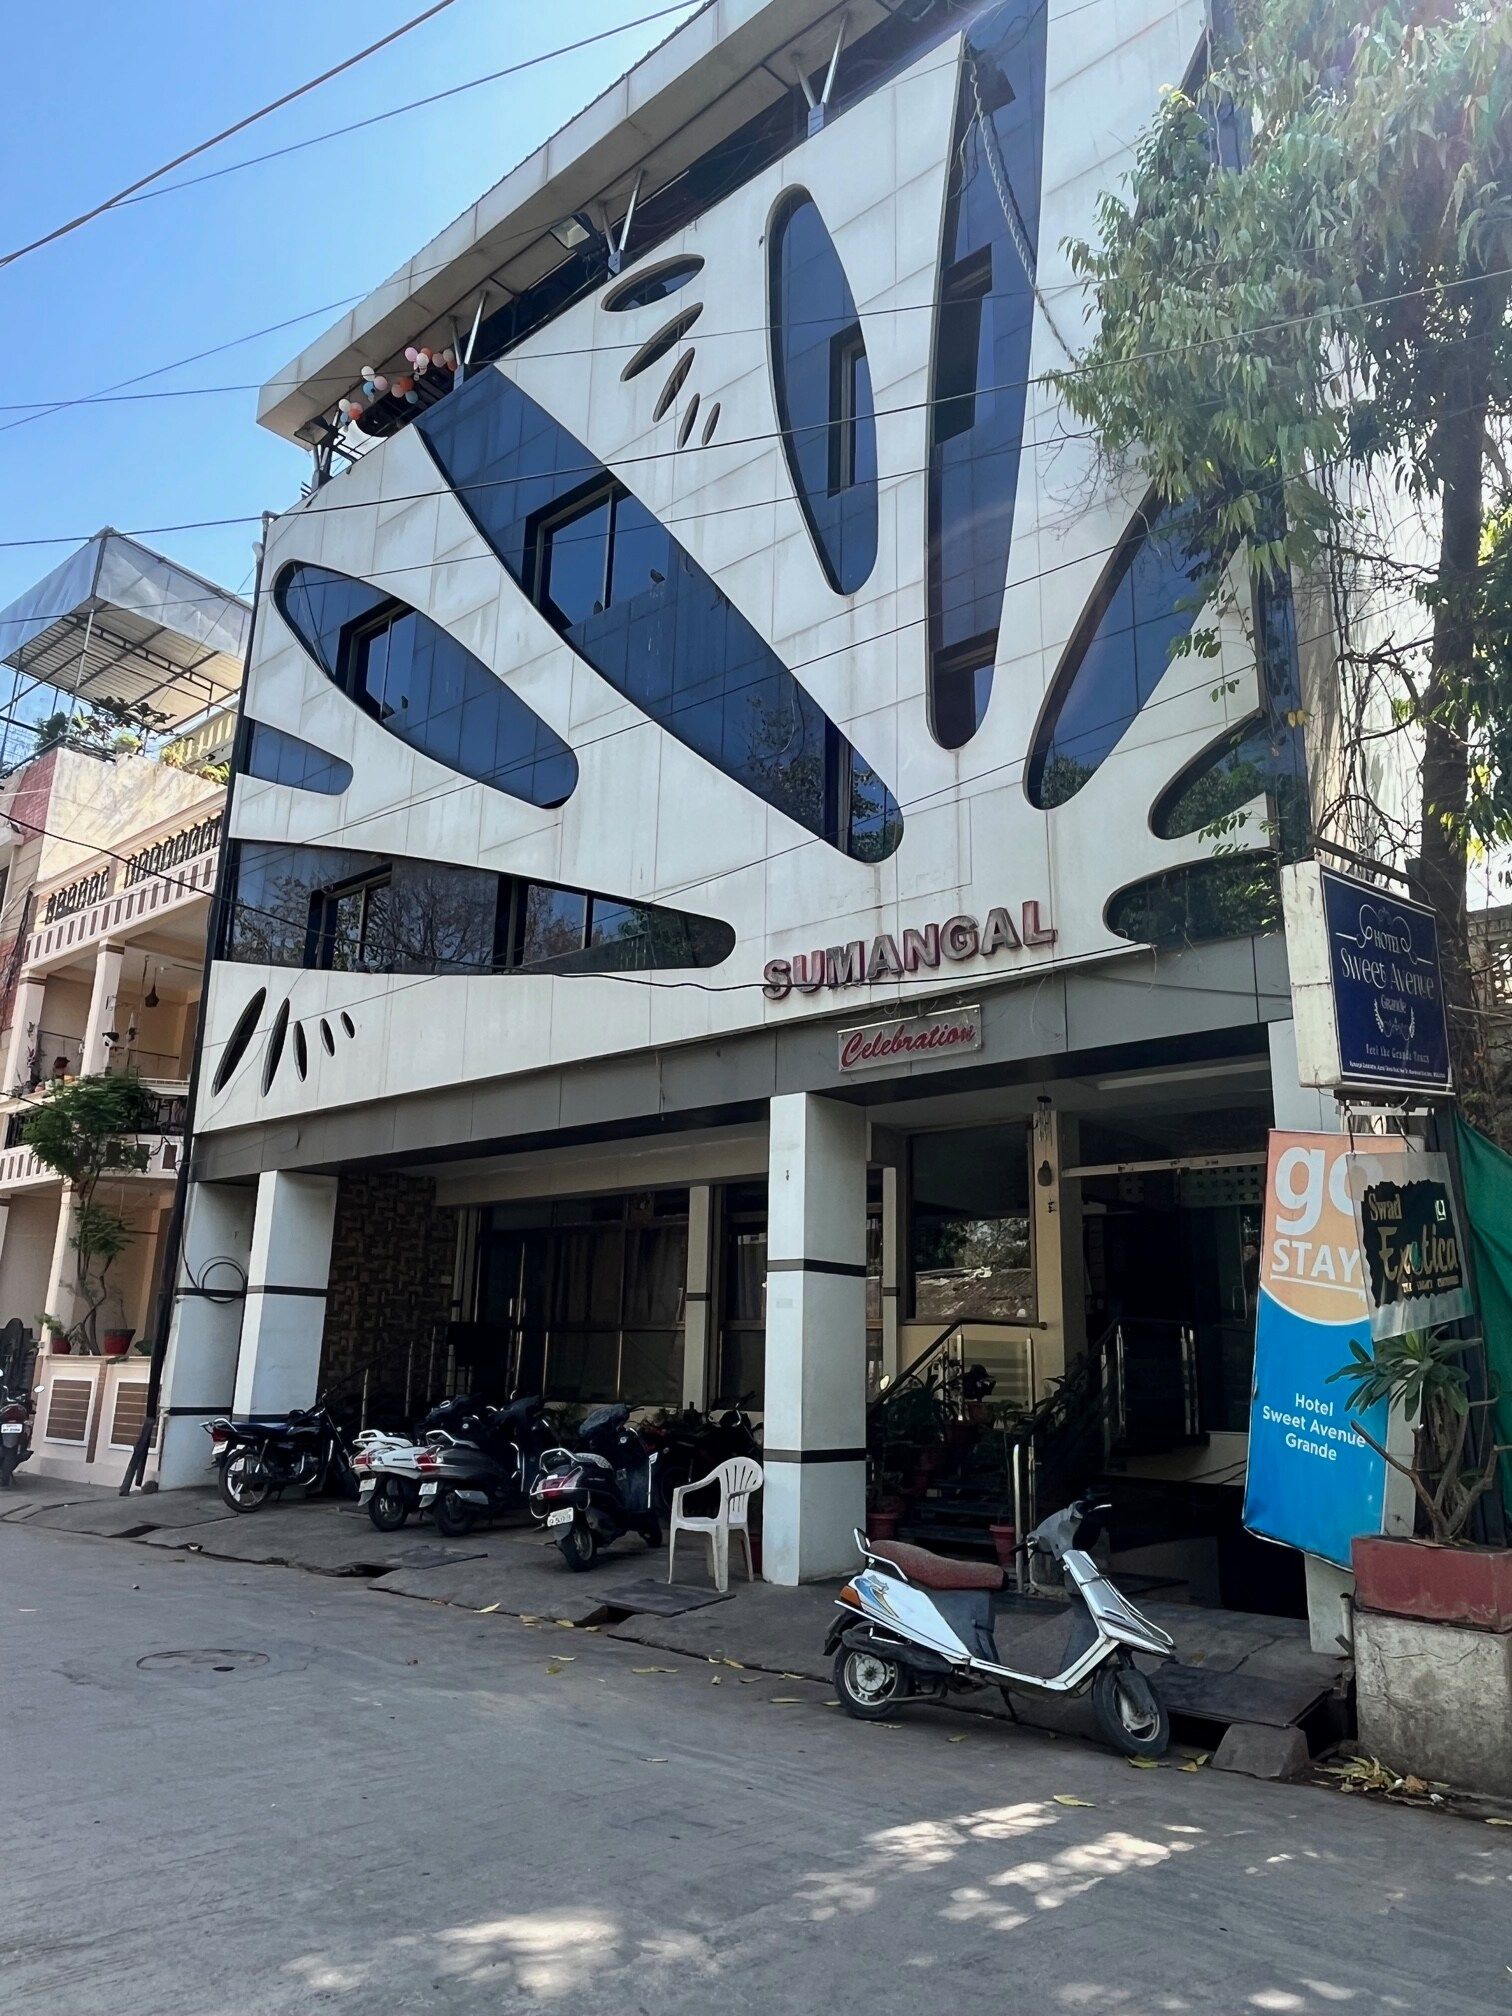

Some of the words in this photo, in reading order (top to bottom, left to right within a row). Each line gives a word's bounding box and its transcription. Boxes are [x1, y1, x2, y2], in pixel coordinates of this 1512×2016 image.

[762, 900, 1058, 1000] SUMANGAL
[1373, 929, 1400, 954] HOTEL
[1341, 948, 1386, 989] Sweet
[1391, 962, 1434, 999] Avenue
[842, 1025, 976, 1068] Celebration
[1369, 1193, 1402, 1220] Swad
[1378, 1223, 1458, 1281] Exotica
[1295, 1392, 1334, 1417] Hotel
[1262, 1405, 1306, 1431] Sweet
[1309, 1419, 1367, 1448] Avenue
[1285, 1432, 1337, 1461] Grande
